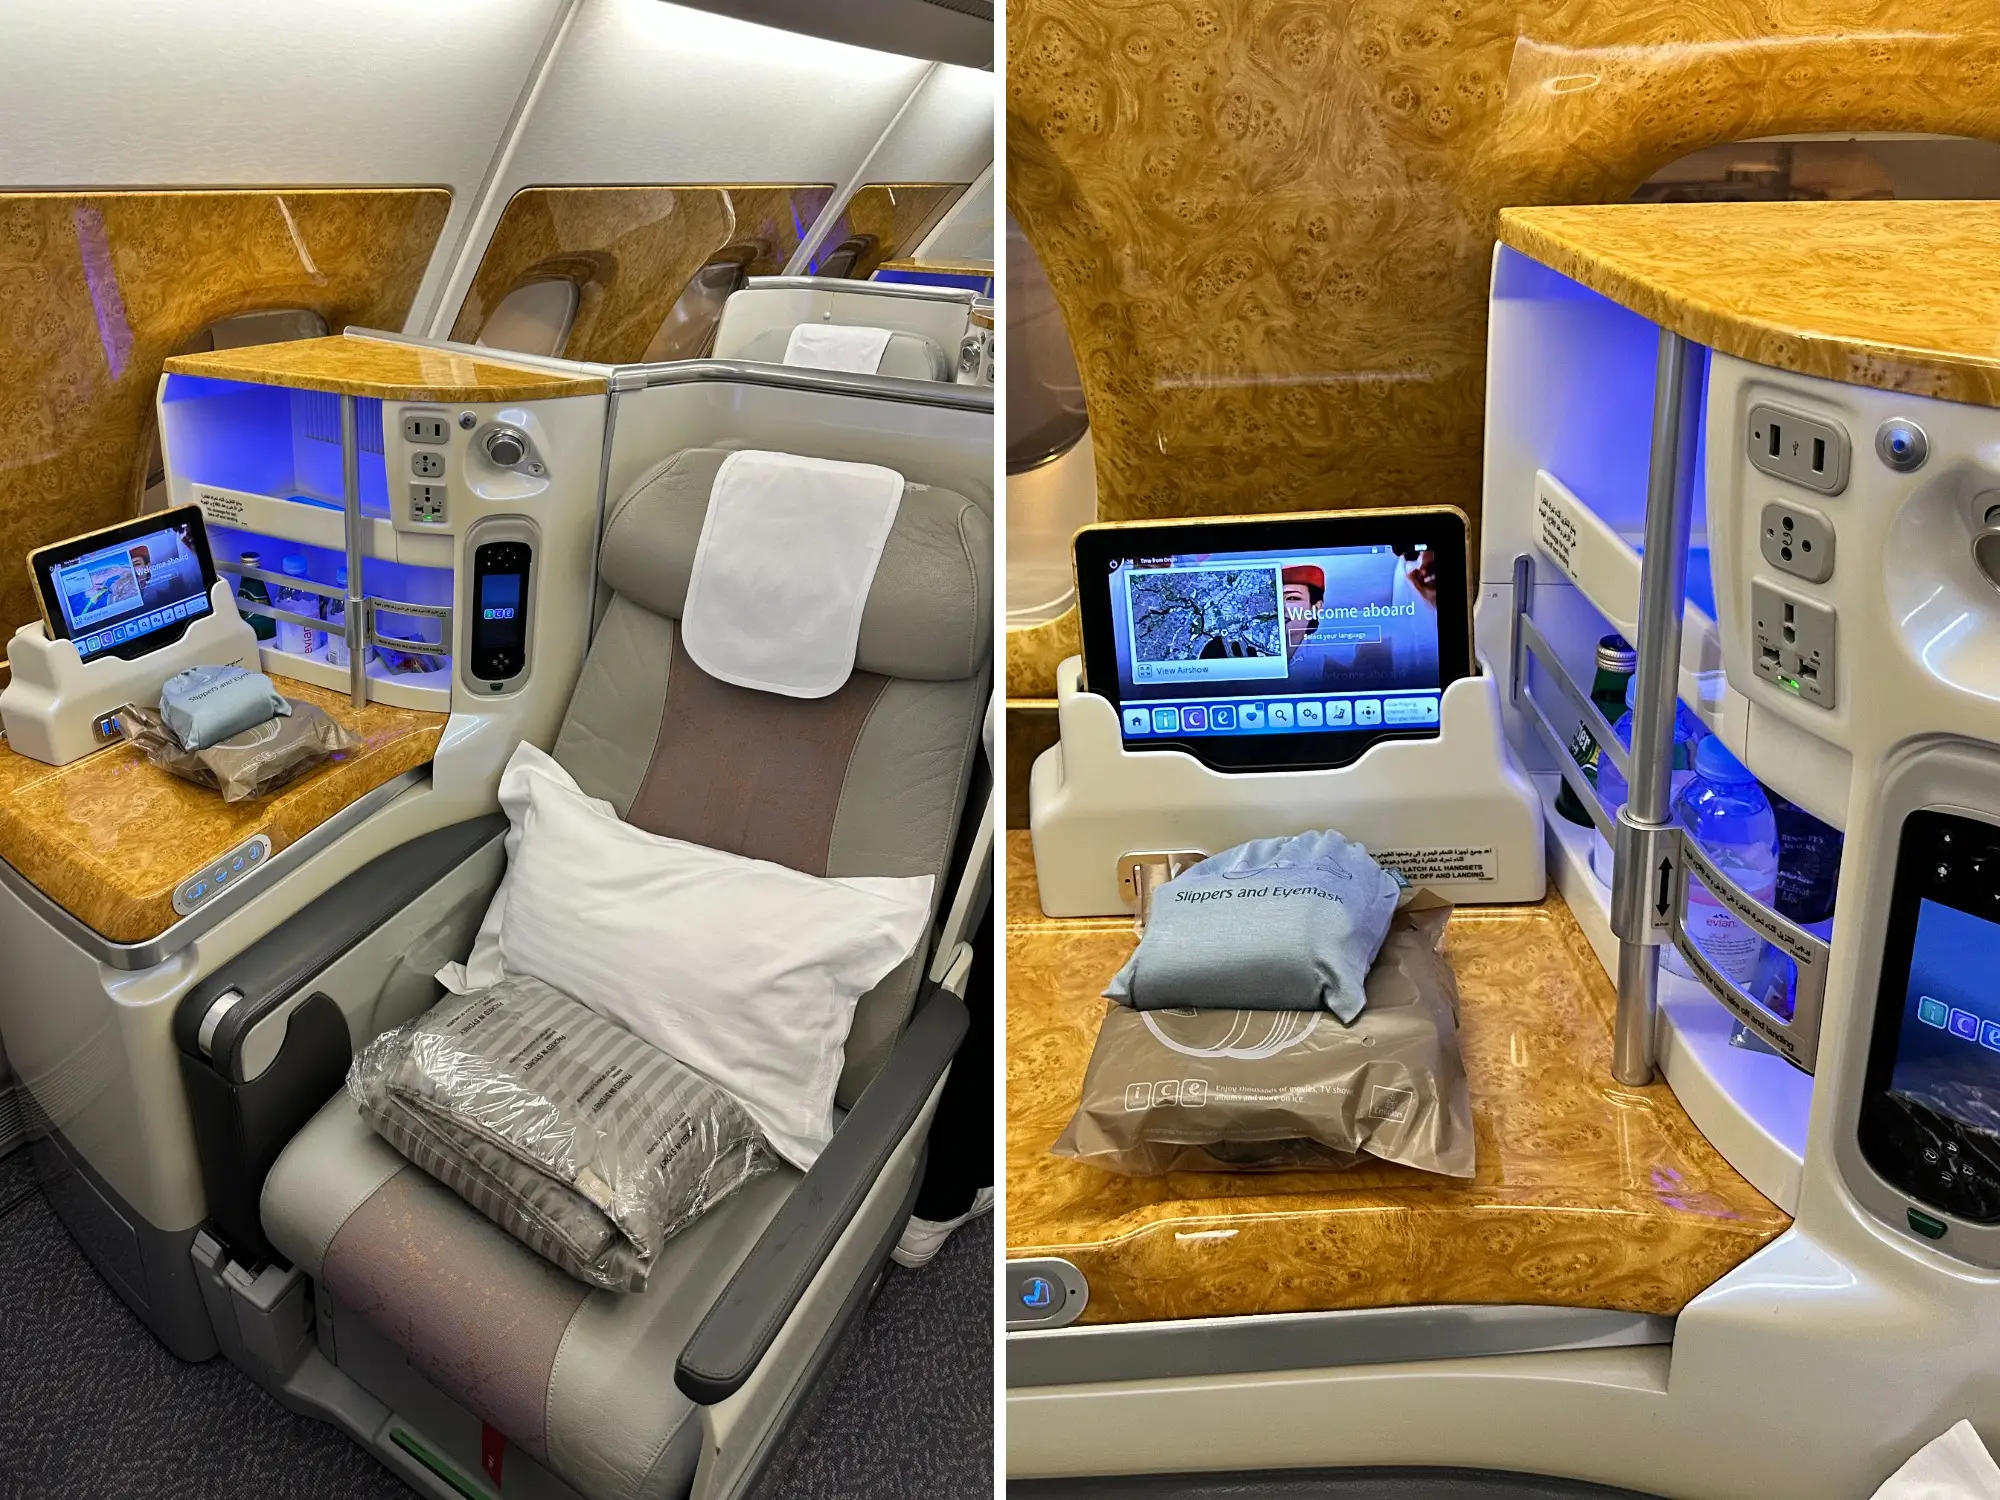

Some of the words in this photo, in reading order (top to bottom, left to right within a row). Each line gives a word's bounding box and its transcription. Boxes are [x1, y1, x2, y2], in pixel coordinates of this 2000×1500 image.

[136, 562, 166, 576] Welcome
[167, 554, 189, 567] aboard
[1287, 605, 1358, 621] Welcome
[1363, 601, 1415, 617] aboard
[1324, 633, 1337, 642] your
[1339, 631, 1366, 641] language
[1157, 667, 1175, 676] View
[1178, 665, 1209, 674] Airshow
[189, 685, 219, 703] Slippers
[220, 679, 233, 688] and
[1175, 888, 1233, 904] Slippers
[1237, 887, 1268, 899] and
[1273, 886, 1344, 904] Eyemask
[1706, 917, 1736, 928] evian
[485, 1002, 505, 1017] PACKED
[459, 1019, 481, 1036] SYDNEY
[1751, 1015, 1766, 1030] and
[1766, 1025, 1794, 1052] landing
[549, 1034, 567, 1051] PACKED
[523, 1054, 543, 1071] SYDNEY
[615, 1073, 633, 1091] PACKED
[1215, 1085, 1237, 1093] Enjoy
[1240, 1086, 1278, 1094] thousands
[1320, 1085, 1331, 1093] TV
[592, 1093, 612, 1113] SYDNEY
